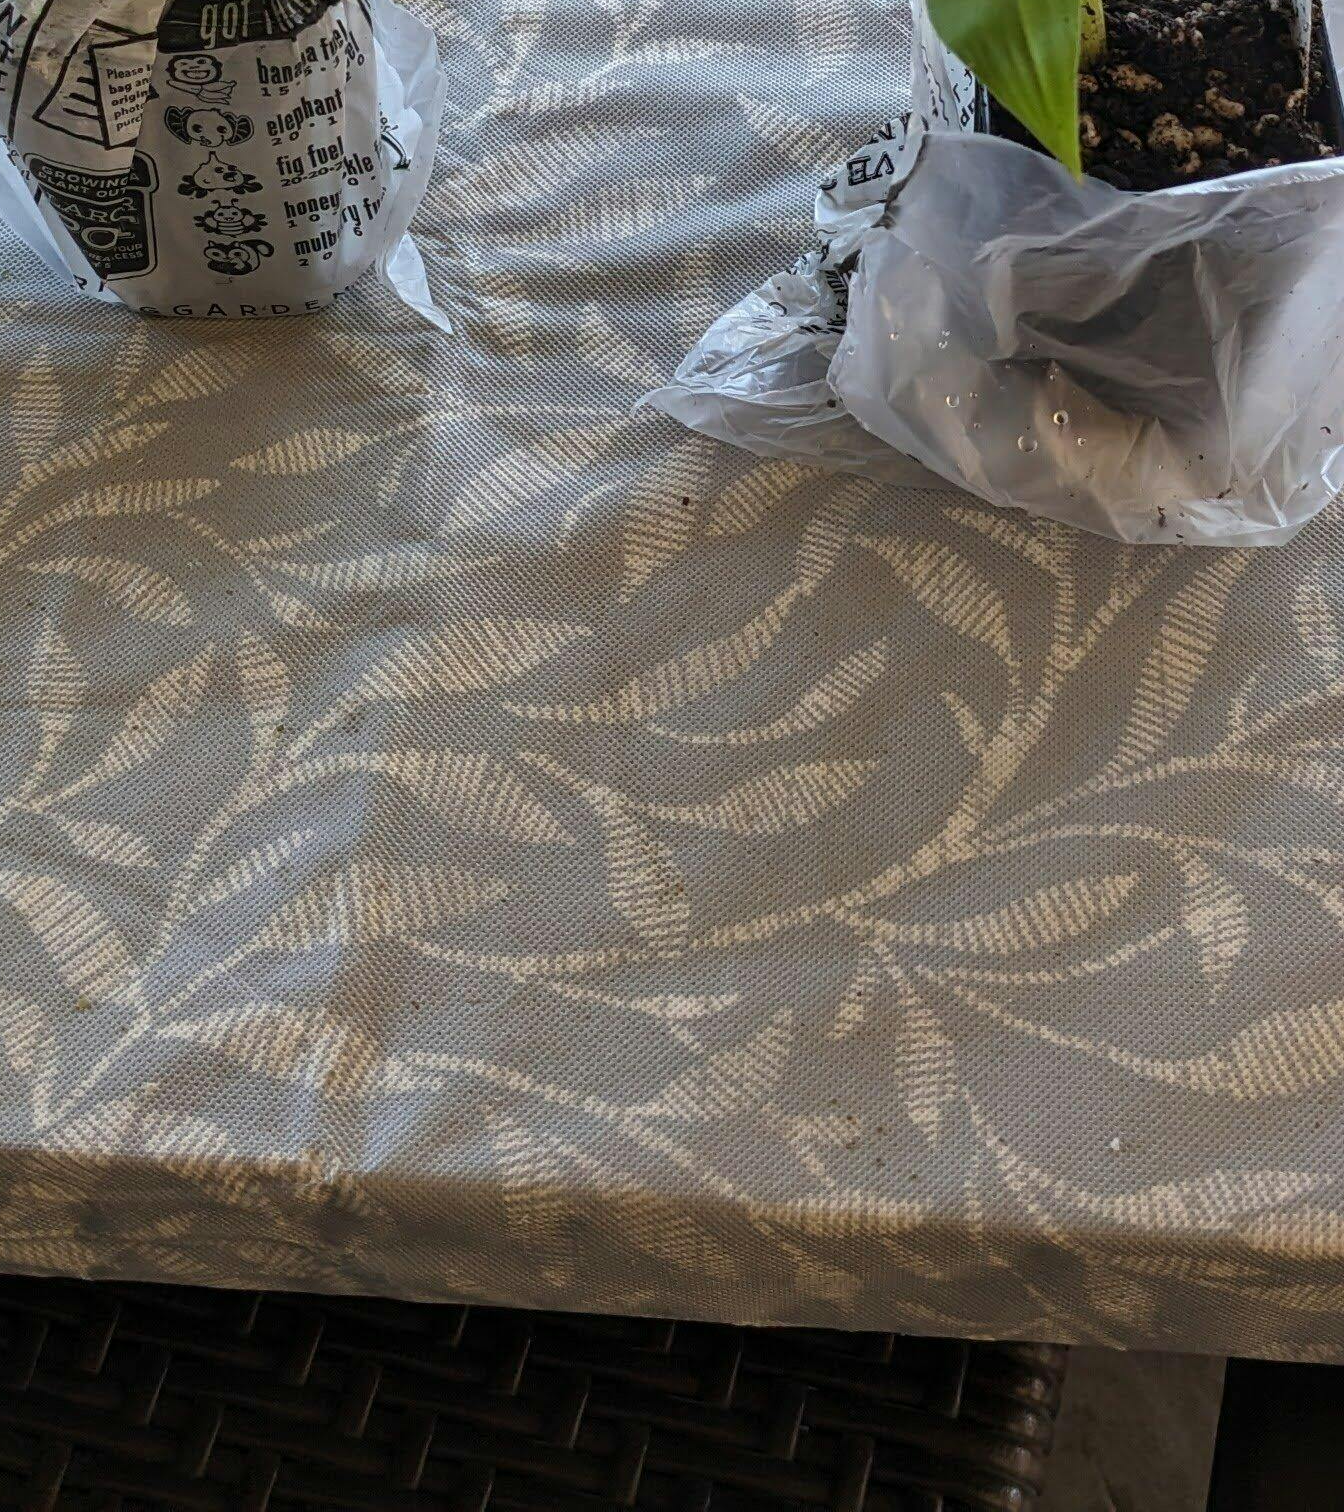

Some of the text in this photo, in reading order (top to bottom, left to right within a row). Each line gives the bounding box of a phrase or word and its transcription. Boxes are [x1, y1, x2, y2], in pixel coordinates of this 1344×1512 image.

[106, 66, 145, 81] Please
[108, 81, 132, 96] bag
[266, 87, 344, 139] elephant
[275, 135, 344, 178] fig fuel
